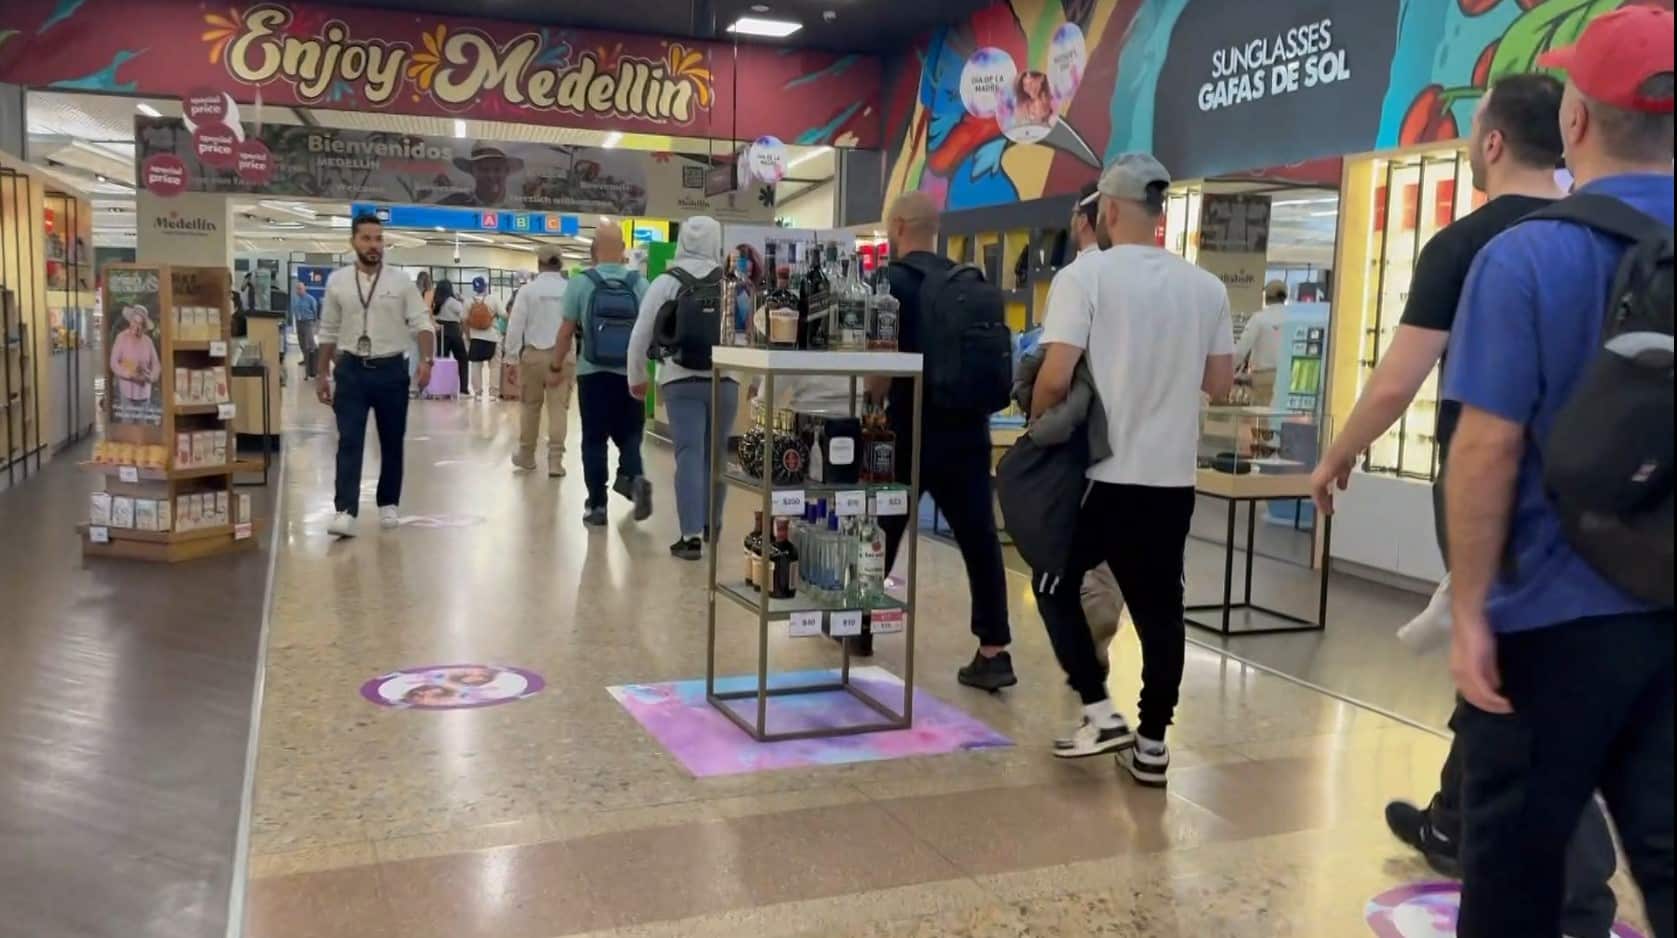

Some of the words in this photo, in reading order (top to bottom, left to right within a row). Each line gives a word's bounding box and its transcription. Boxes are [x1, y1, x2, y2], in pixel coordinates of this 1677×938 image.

[1211, 17, 1332, 78] SUNGLASSES
[231, 9, 408, 101] Enjoy
[433, 32, 695, 122] Medellin
[1198, 69, 1266, 112] GAFAS
[1271, 60, 1300, 96] DE
[1303, 48, 1351, 88] SOL
[190, 102, 222, 117] price
[198, 142, 233, 155] price
[307, 133, 453, 161] Bienvenidos
[238, 159, 267, 171] price
[148, 173, 182, 186] price
[484, 213, 496, 227] A
[516, 216, 526, 228] B
